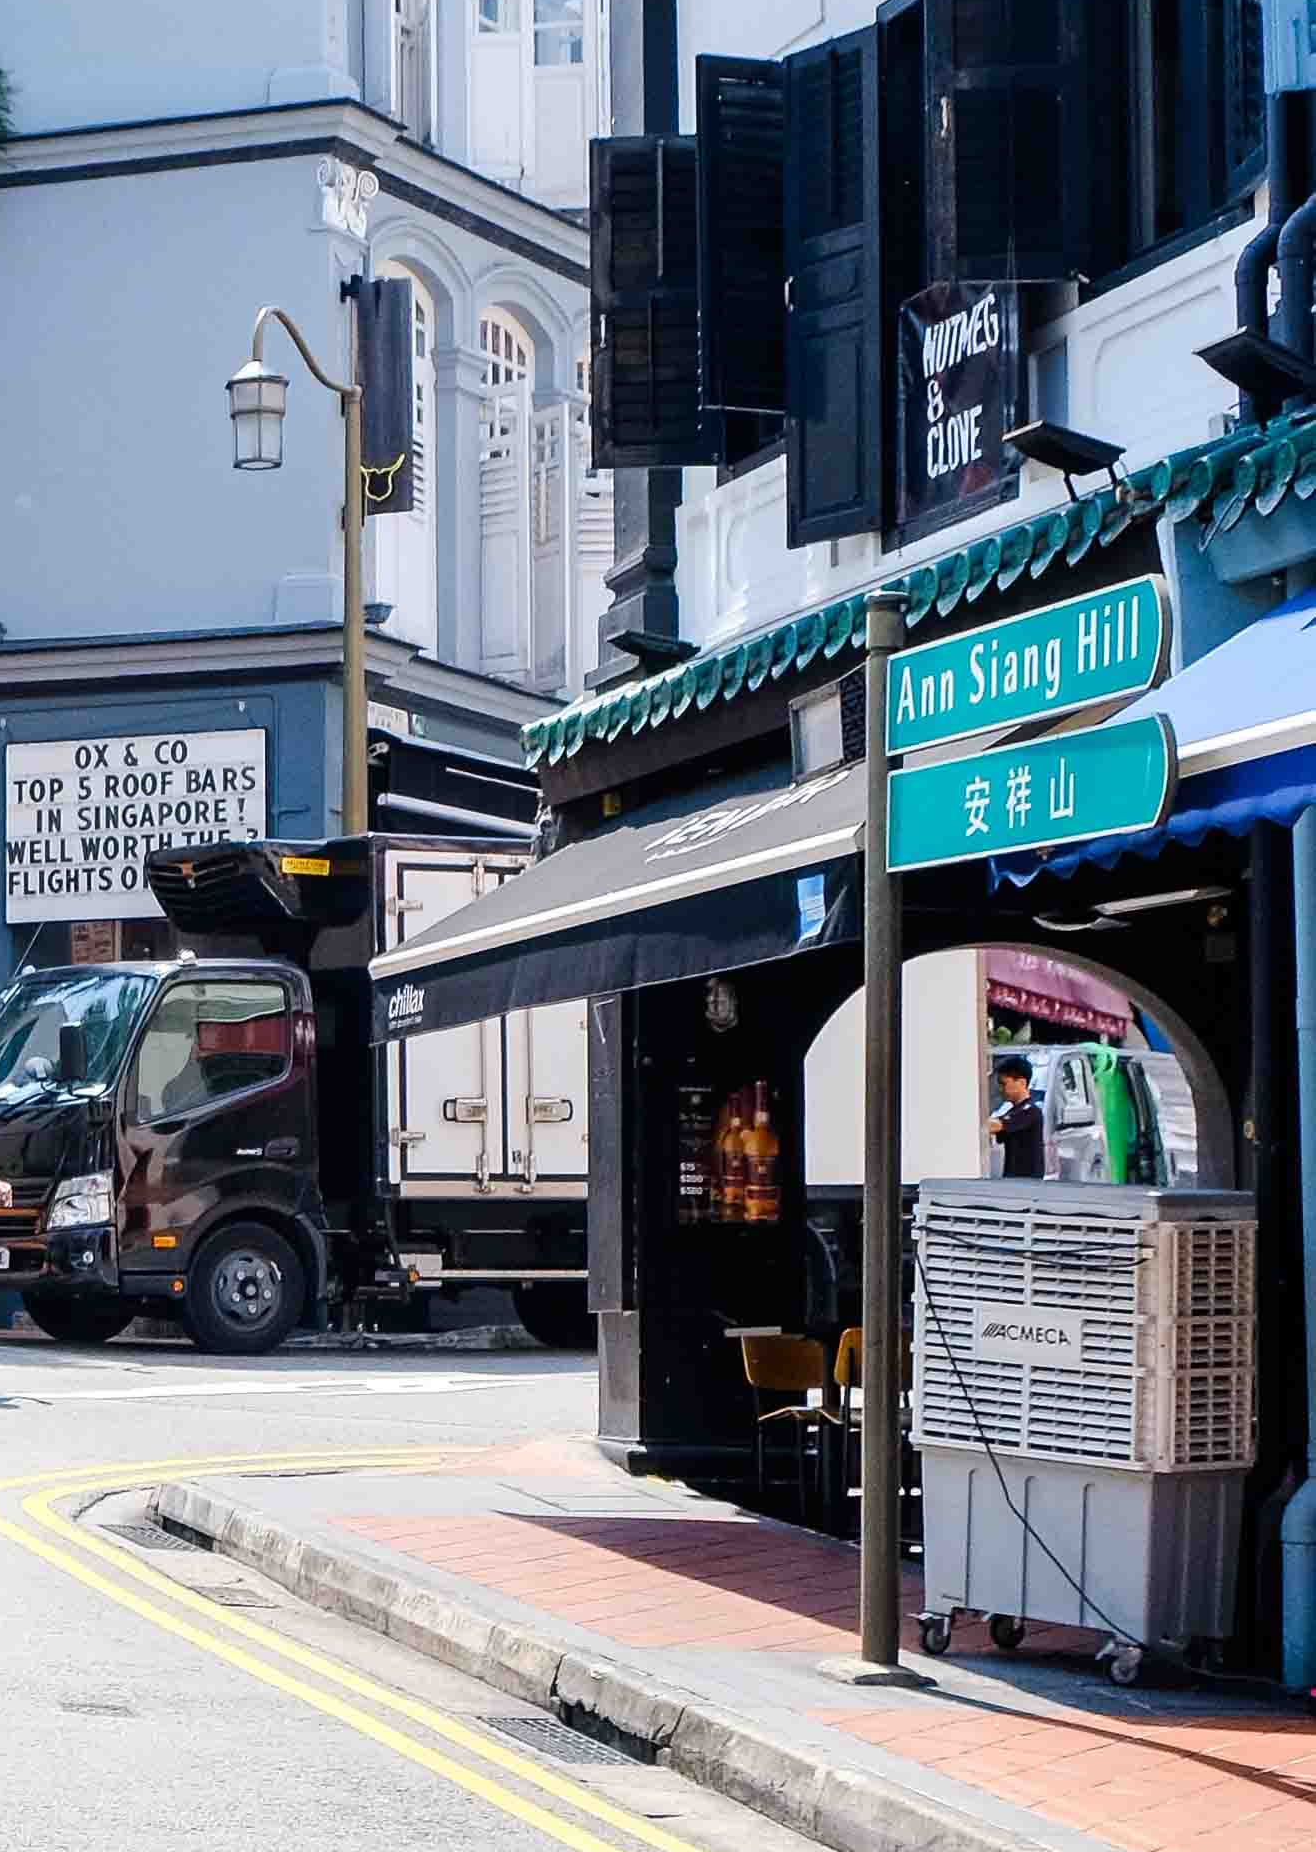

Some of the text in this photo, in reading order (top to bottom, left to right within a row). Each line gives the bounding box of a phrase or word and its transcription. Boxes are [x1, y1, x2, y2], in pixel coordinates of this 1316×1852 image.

[923, 293, 999, 379] NUTMEG
[927, 380, 944, 423] &
[927, 404, 983, 479] CLOVE
[897, 596, 1139, 724] Ann Siang Hill
[75, 740, 188, 770] OX & CO
[13, 766, 256, 804] TOP 5 ROOF BARS
[964, 757, 1075, 837] 安祥山
[36, 808, 62, 833] IN
[7, 837, 73, 865] WELL
[8, 866, 149, 895] FLIGHTS O
[388, 983, 425, 1019] chillax
